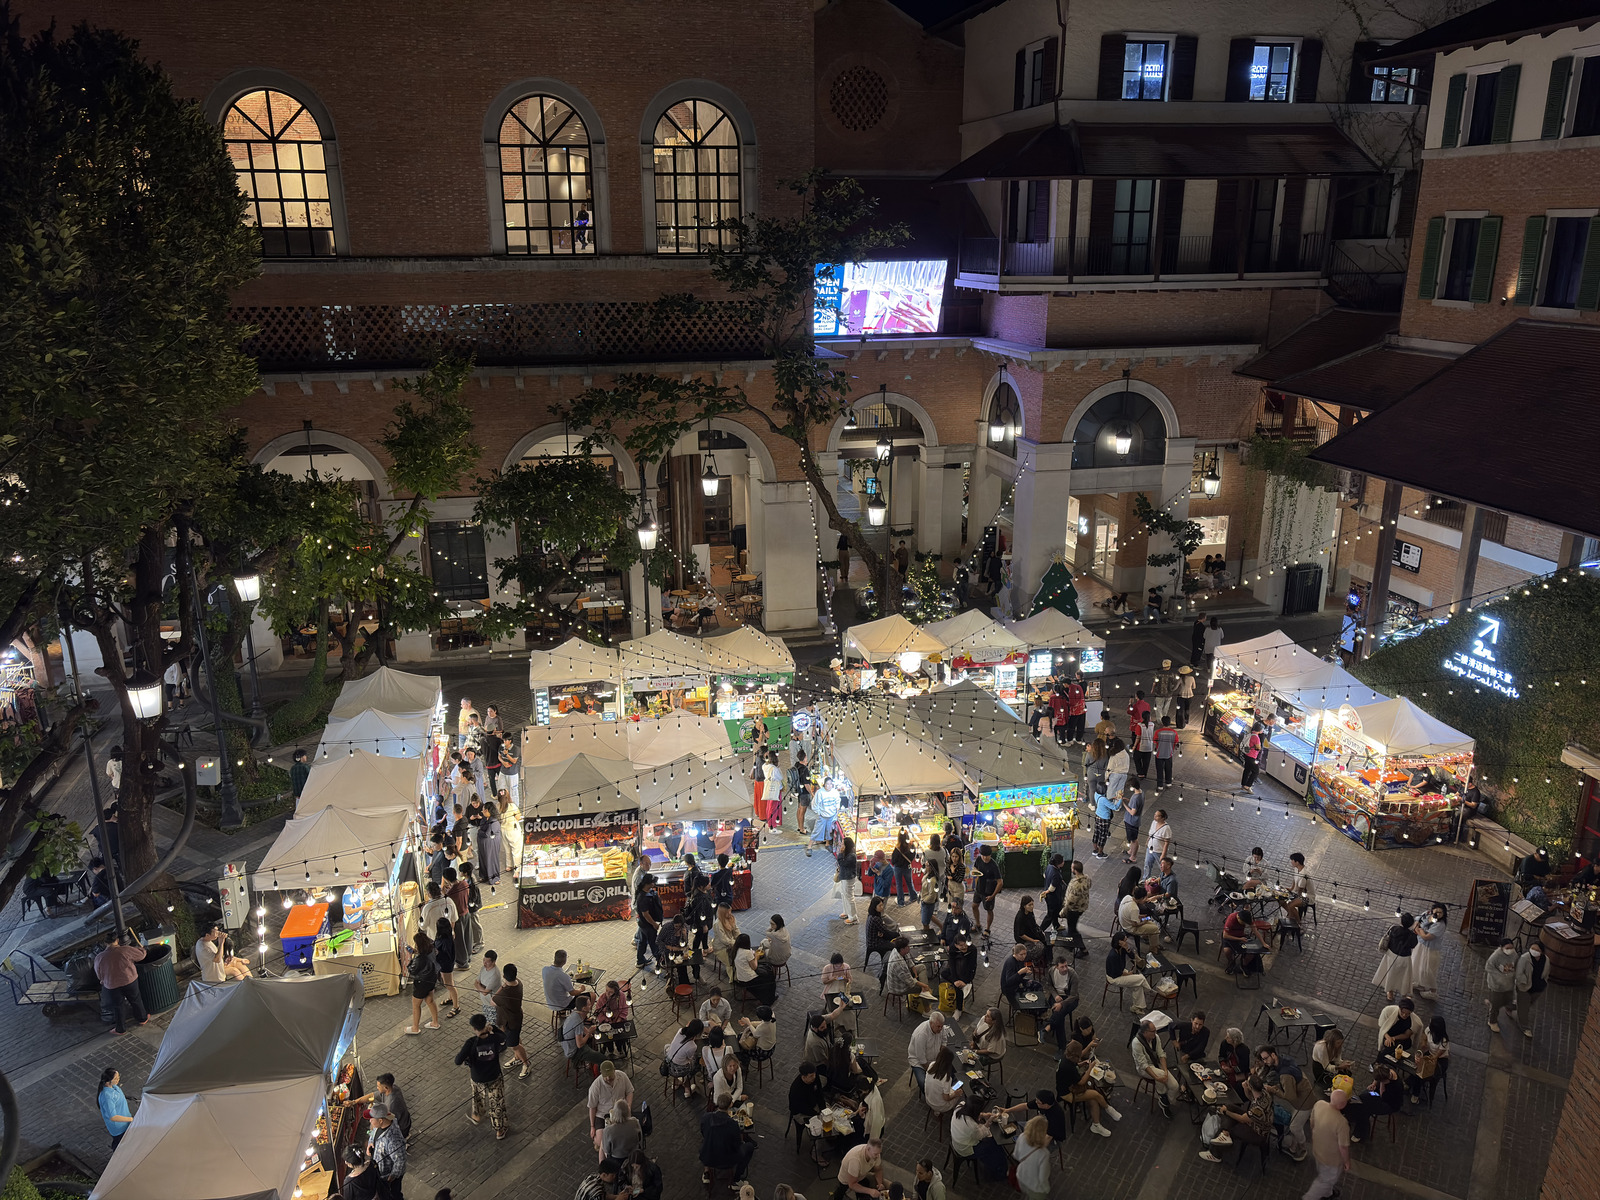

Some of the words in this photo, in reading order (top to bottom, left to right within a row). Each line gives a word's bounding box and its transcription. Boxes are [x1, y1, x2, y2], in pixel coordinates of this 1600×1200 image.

[1493, 680, 1520, 699] Craft
[524, 817, 592, 833] CROCODILE
[522, 889, 586, 905] CROCODILE
[477, 1049, 494, 1057] FILA
